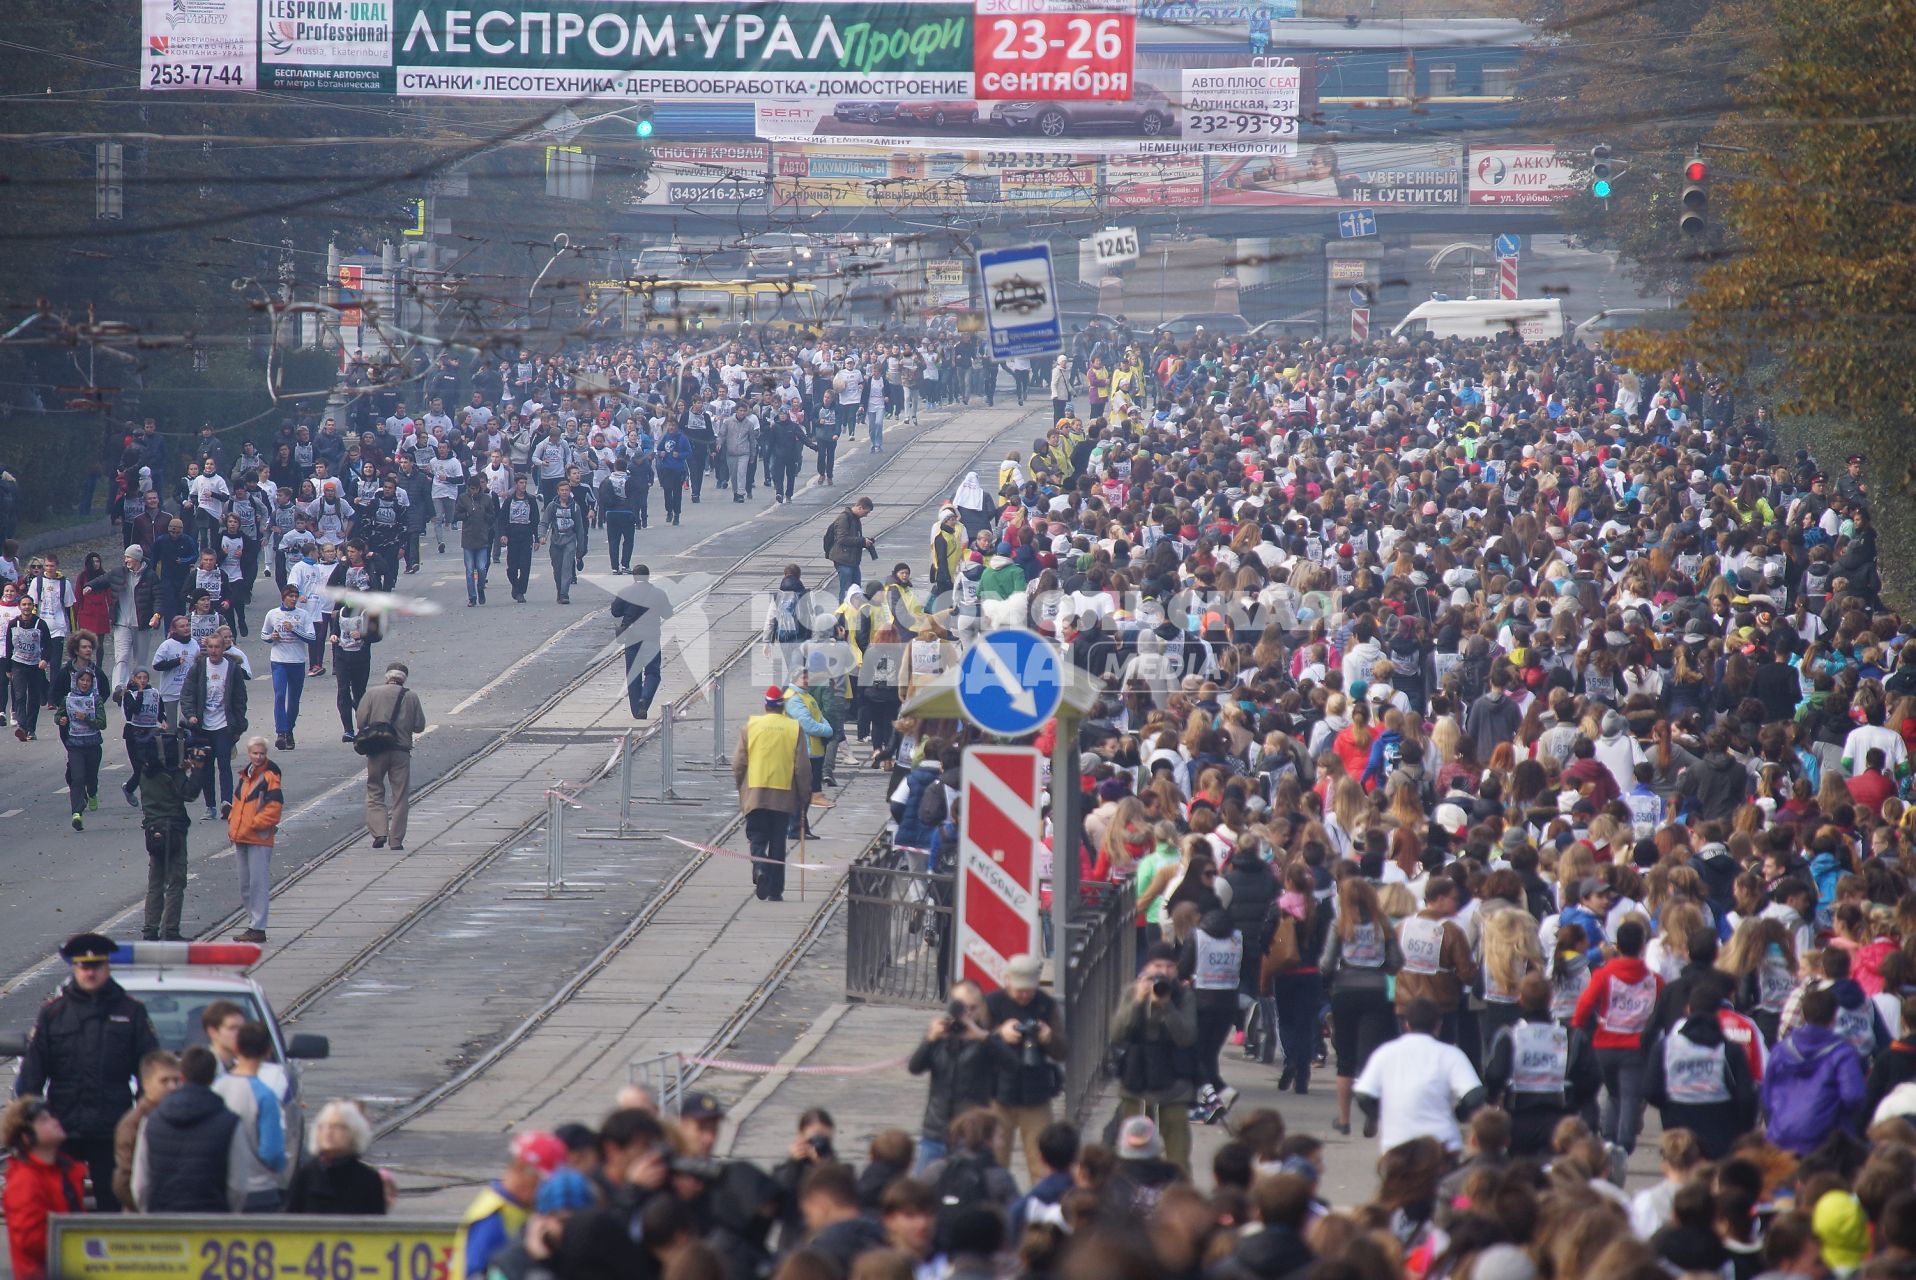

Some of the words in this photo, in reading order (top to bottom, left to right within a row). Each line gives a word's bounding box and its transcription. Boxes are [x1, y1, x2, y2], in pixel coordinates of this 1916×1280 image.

[350, 2, 388, 21] URAL
[296, 22, 388, 42] Professional
[992, 19, 1122, 60] 23-26
[296, 46, 327, 56] Russia,
[332, 47, 389, 58] Ekaterinburg
[839, 16, 966, 76] Профи
[150, 64, 243, 86] 253-77-44
[275, 69, 331, 79] БЕСПЛАТНЫЕ
[333, 70, 380, 79] АВТОБУСЫ
[982, 65, 1128, 96] сентября
[286, 80, 315, 88] метро
[317, 80, 381, 89] Ботаническая
[403, 74, 473, 90] СТАНКИ
[483, 76, 616, 92] ЛЕСОТЕХНИКА
[626, 78, 808, 95] ДЕРЕВООБРАБОТКА
[817, 80, 968, 95] ДОМОСТРОЕНИЕ
[1192, 77, 1224, 88] АВТО
[1227, 77, 1266, 88] ПЛЮС
[1190, 97, 1268, 111] Артинская,
[761, 109, 814, 118] SEAT
[1190, 115, 1295, 134] 232-93-93
[711, 147, 763, 158] КРОВЛИ
[1139, 142, 1204, 153] НЕМЕЦКИЕ
[1208, 143, 1287, 154] ТЕХНОЛОГИИ
[783, 163, 806, 174] АВТО
[811, 163, 885, 174] АККУМУЛЯТОРЫ
[1367, 169, 1458, 185] УВЕРЕННЫЙ
[1512, 173, 1548, 185] МИР
[670, 187, 764, 203] (343)216-25-62
[835, 189, 848, 200] 27
[1353, 188, 1372, 202] НЕ
[1378, 188, 1458, 203] СУЕТИТСЯ!
[1500, 194, 1514, 204] ул.
[1096, 235, 1138, 258] 1245
[1407, 938, 1434, 955] 8573
[1208, 952, 1236, 966] 8227
[200, 1238, 435, 1280] 268-46-10
